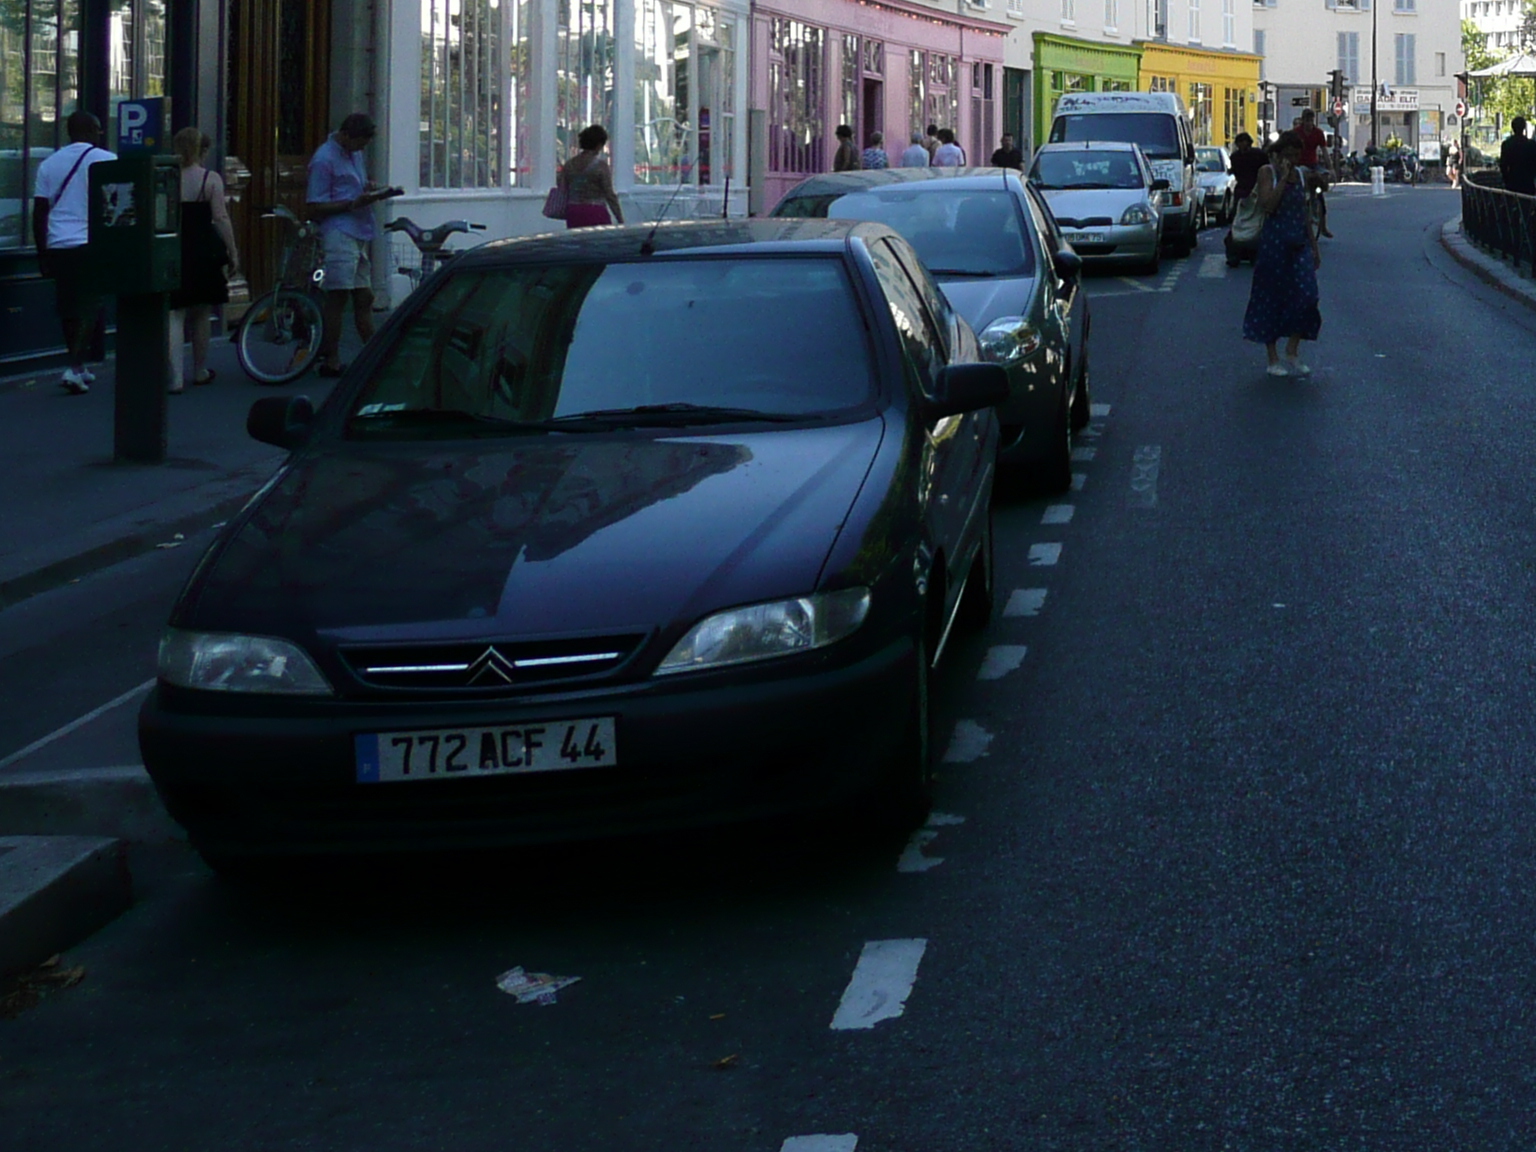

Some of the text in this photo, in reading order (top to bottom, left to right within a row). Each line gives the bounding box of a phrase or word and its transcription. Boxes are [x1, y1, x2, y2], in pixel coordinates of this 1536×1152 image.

[120, 103, 148, 137] P
[392, 733, 468, 775] 772
[478, 728, 546, 770] ACF
[560, 724, 605, 763] 44
